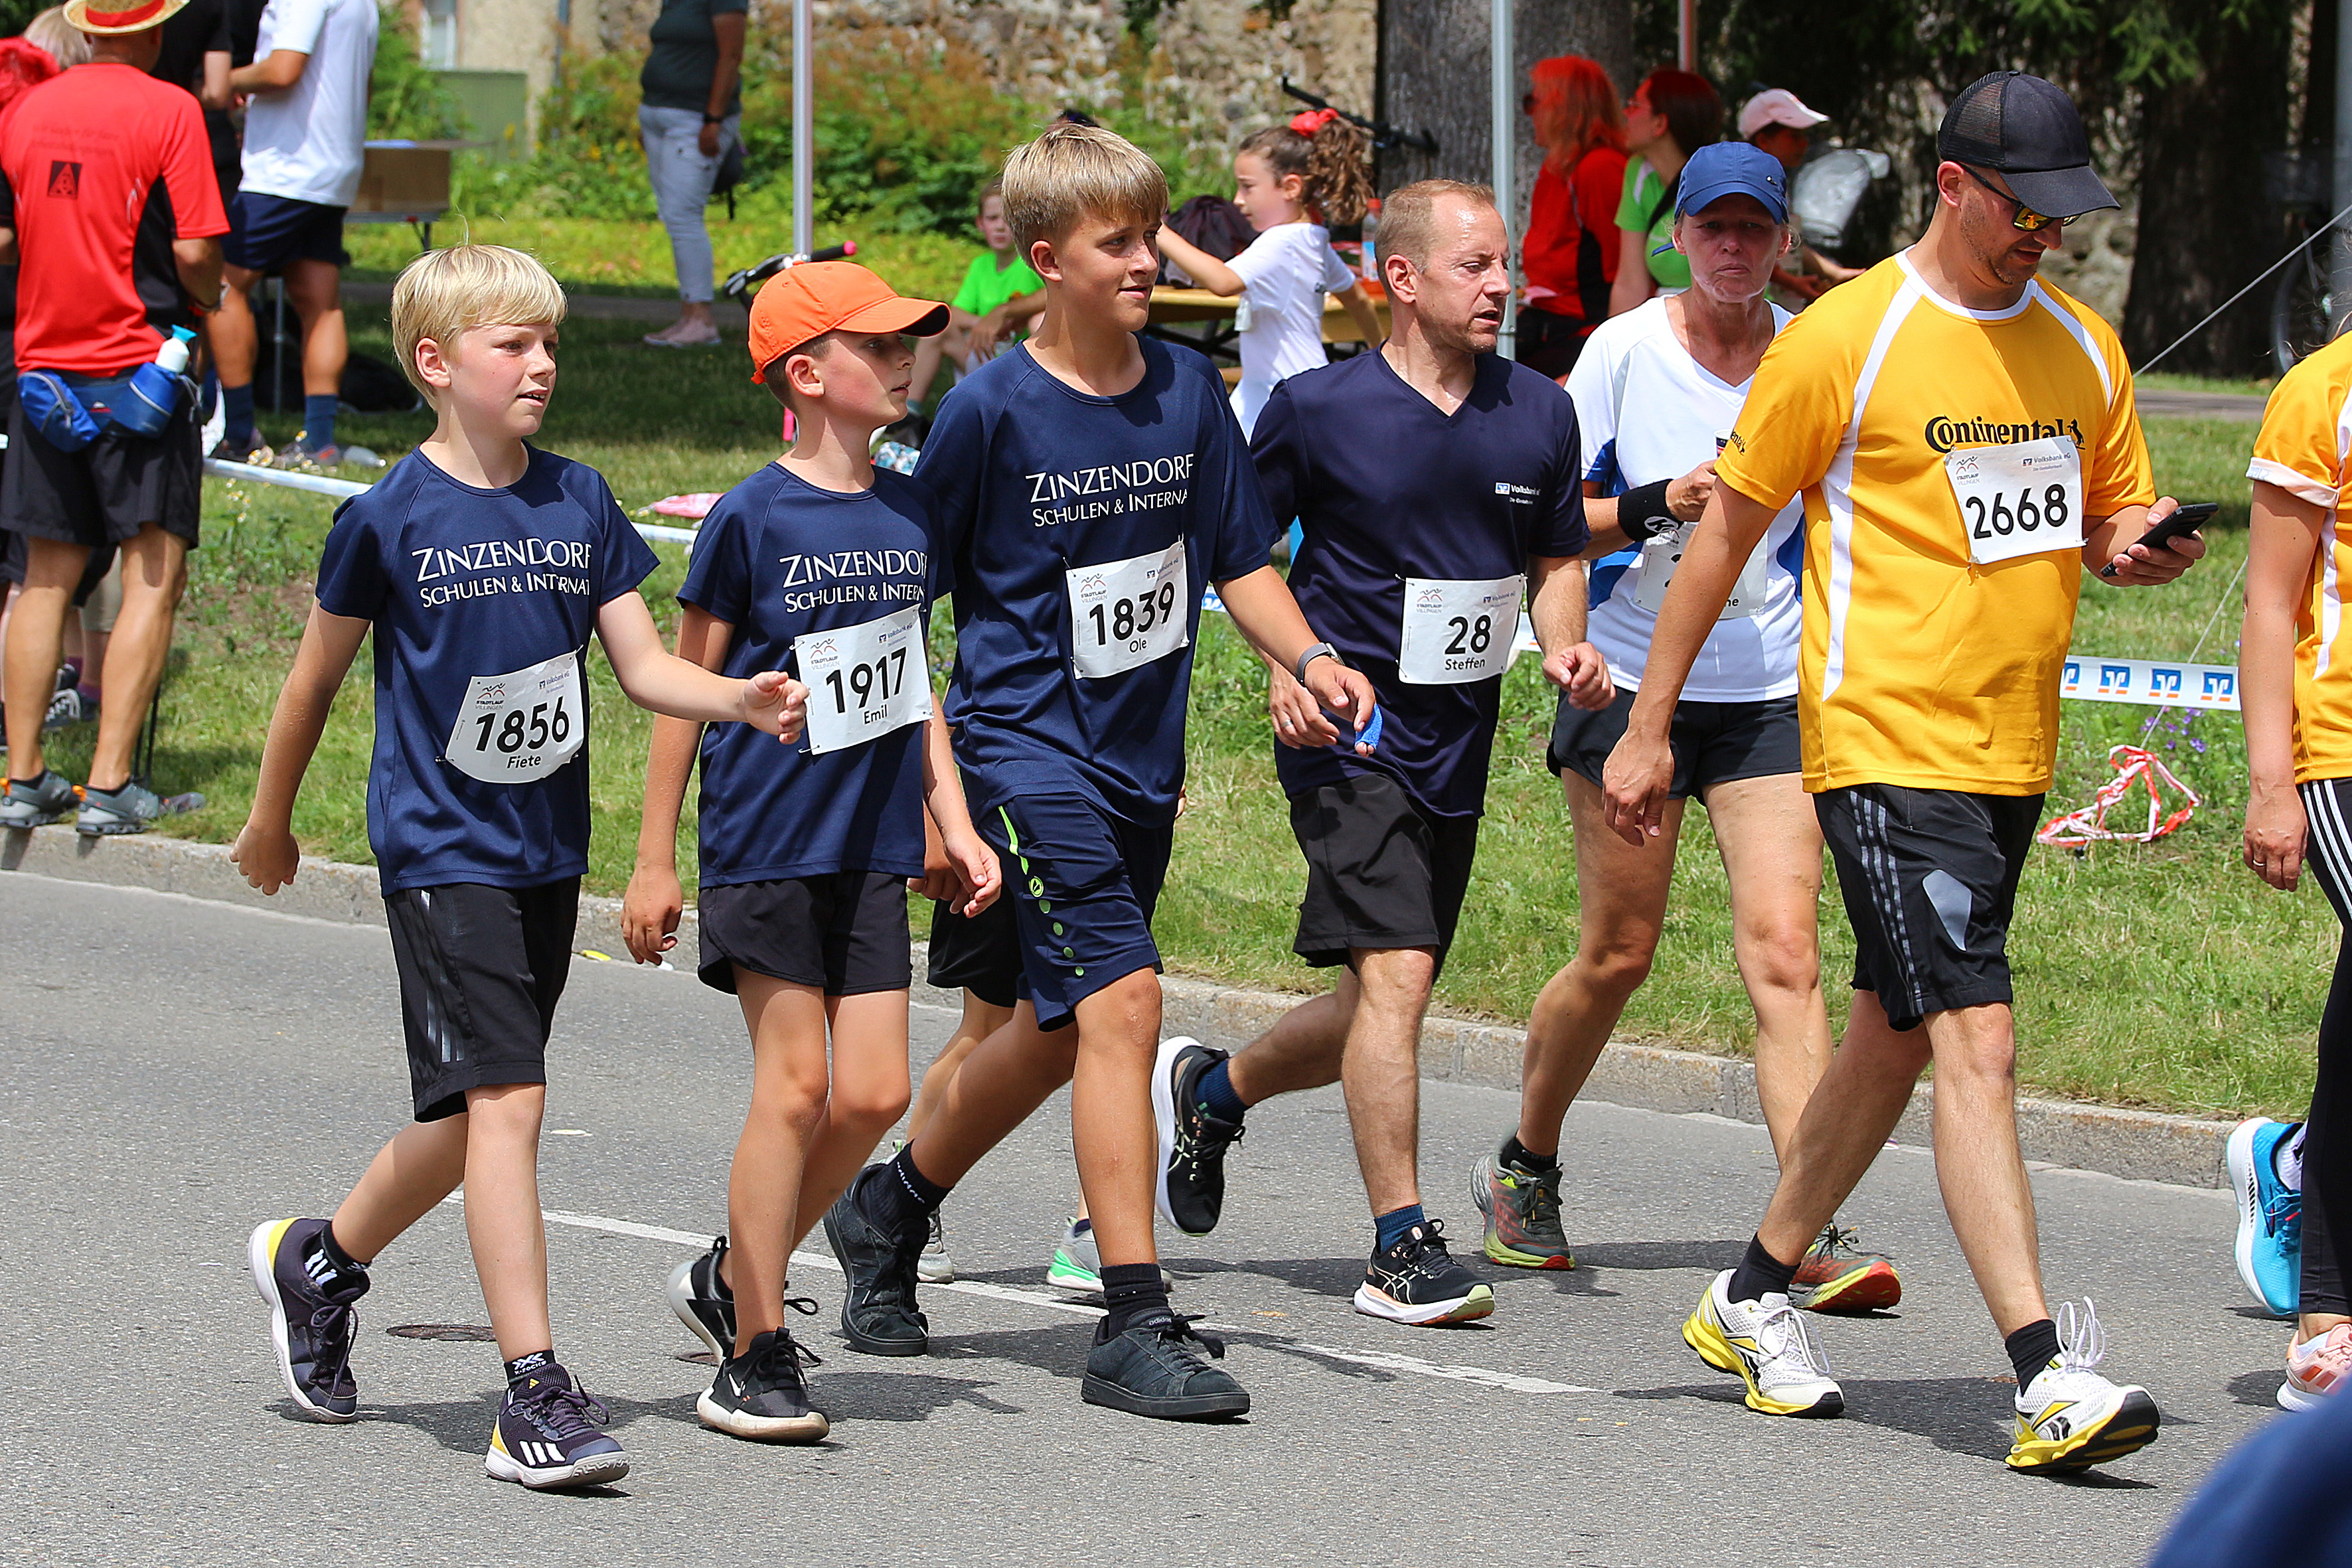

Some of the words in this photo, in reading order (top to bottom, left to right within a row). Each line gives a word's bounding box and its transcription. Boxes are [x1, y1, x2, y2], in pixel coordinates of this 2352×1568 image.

[1925, 414, 2064, 454] Continental
[2033, 454, 2063, 463] Volksbank
[1026, 453, 1194, 503] ZINZENDORF
[1032, 501, 1110, 527] SCHULEN
[1114, 499, 1124, 514] &
[1966, 484, 2068, 539] 2668
[420, 576, 507, 608] SCHULEN
[511, 576, 522, 592] &
[785, 585, 864, 613] SCHULEN
[868, 585, 878, 601] &
[1081, 589, 1107, 598] STADTLAUF
[1081, 595, 1108, 603] VILLINGEN
[1089, 582, 1175, 646] 1839
[1129, 638, 1147, 653] Ole
[1445, 615, 1491, 655] 28
[811, 656, 838, 665] STADTLAUF
[811, 661, 840, 670] VILLINGEN
[1445, 657, 1486, 670] Steffen
[826, 647, 907, 714] 1917
[475, 696, 570, 753] 1856
[864, 704, 888, 724] Emil
[507, 755, 541, 769] Fiete
